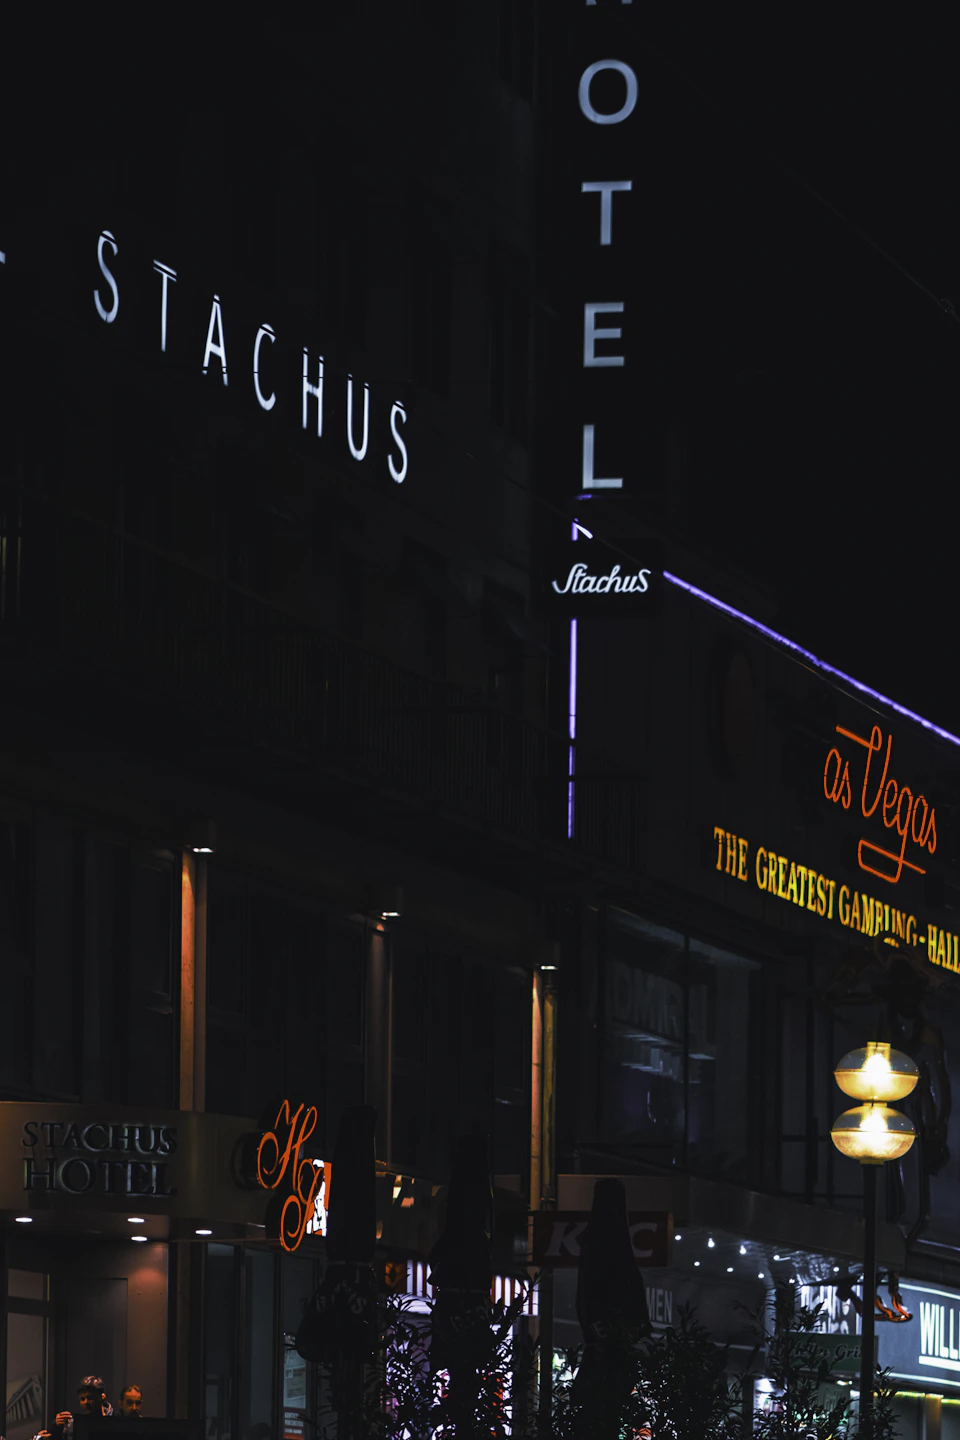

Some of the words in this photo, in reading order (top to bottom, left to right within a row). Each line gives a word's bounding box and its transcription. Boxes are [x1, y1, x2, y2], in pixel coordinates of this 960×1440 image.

[578, 0, 638, 489] OTEL
[93, 230, 409, 484] STACHUS
[713, 827, 748, 880] THE
[756, 847, 836, 918] GREATEST
[21, 1121, 178, 1155] STACHUS
[22, 1156, 178, 1197] HOTEL
[543, 1221, 658, 1258] KC
